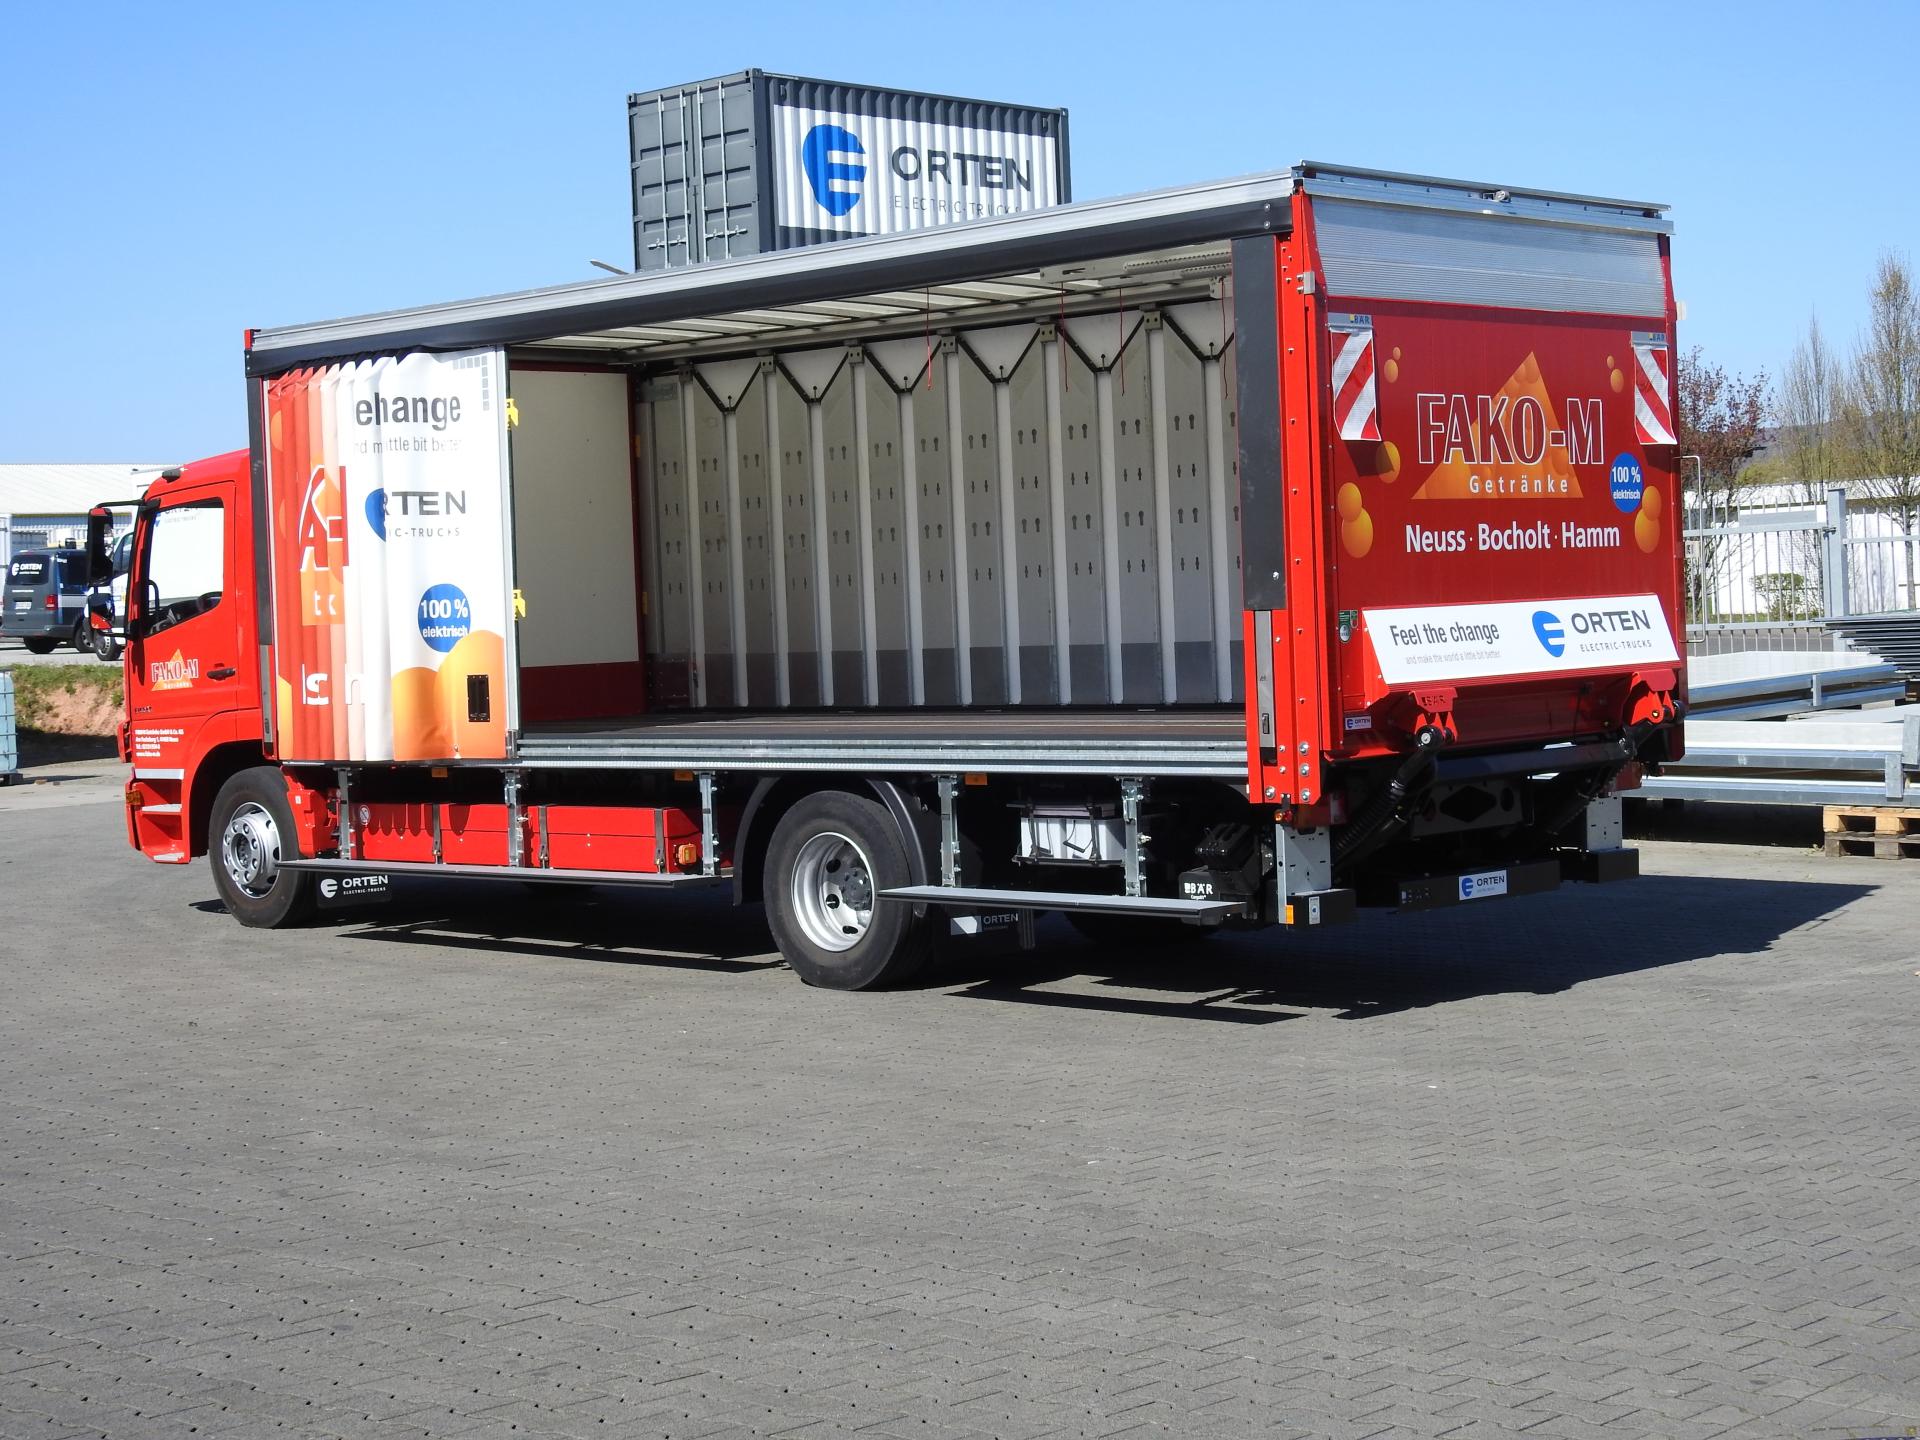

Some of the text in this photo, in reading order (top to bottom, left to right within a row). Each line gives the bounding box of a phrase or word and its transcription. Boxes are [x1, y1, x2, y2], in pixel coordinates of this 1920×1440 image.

[892, 146, 1031, 192] ORTEN
[1417, 393, 1604, 465] FAKO-M
[414, 437, 428, 452] bit
[1612, 466, 1640, 483] 100 %
[1469, 475, 1568, 493] Getränke
[1613, 489, 1640, 500] elektrisch
[1406, 521, 1620, 552] Neuss Bocholt Hamm
[421, 598, 468, 619] 100 %
[1571, 610, 1651, 634] ORTEN
[422, 625, 468, 638] elektrisch
[1390, 621, 1500, 646] Feel the change
[1580, 639, 1652, 652] ELECTRIC-TRUCKS
[151, 659, 199, 682] FAKO-M
[342, 875, 388, 888] ORTEN
[1190, 883, 1213, 894] BÄR
[1476, 875, 1504, 887] ORTEN
[344, 887, 386, 895] ELECTRIC-TRUCKS
[983, 913, 1018, 924] ORTEN
